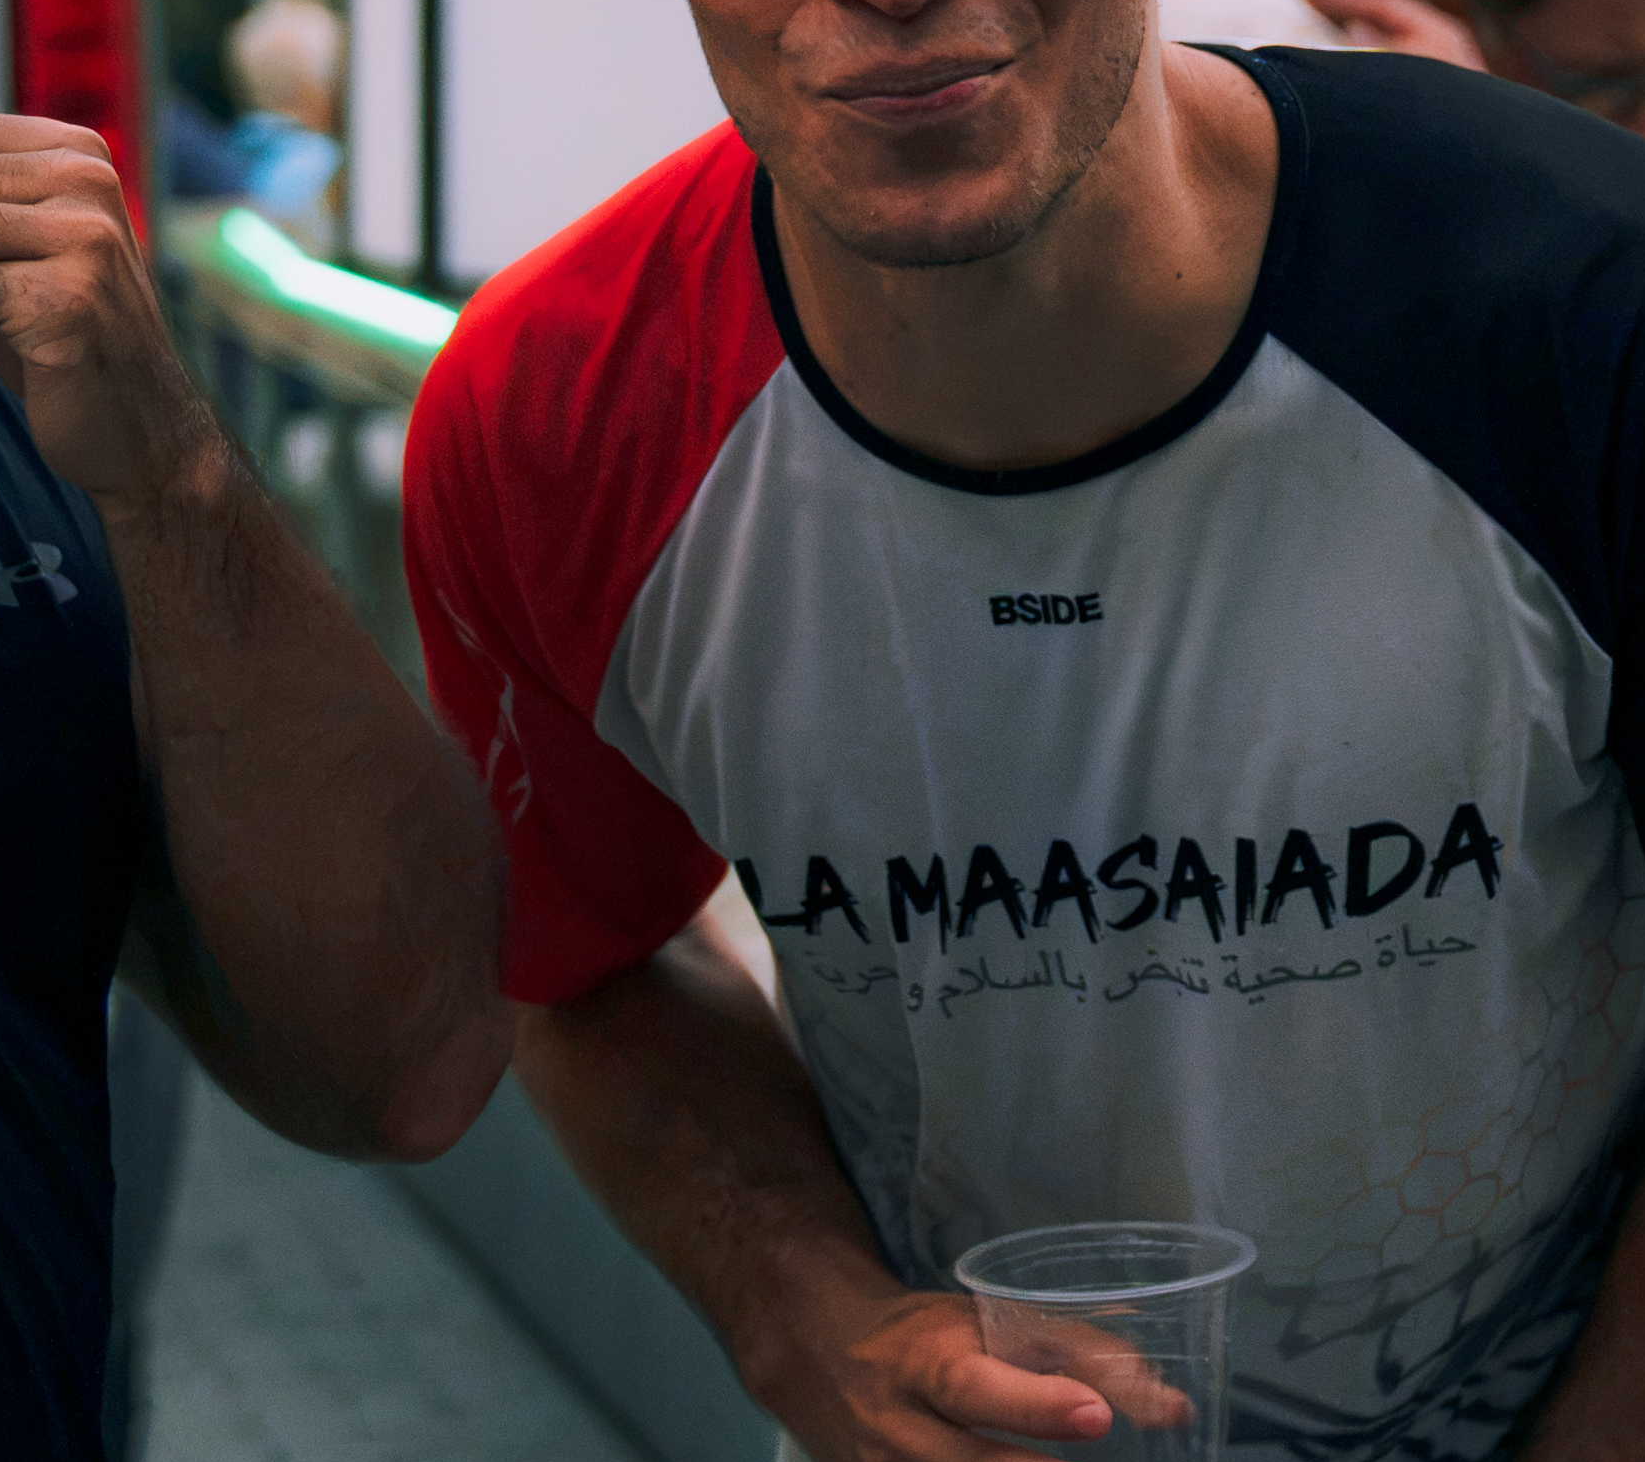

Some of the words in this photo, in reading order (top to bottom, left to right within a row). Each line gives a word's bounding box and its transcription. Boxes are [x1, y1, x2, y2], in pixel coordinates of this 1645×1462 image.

[989, 592, 1104, 627] BSIDE
[735, 854, 871, 944] LA
[886, 801, 1504, 954] MAASAIADA
